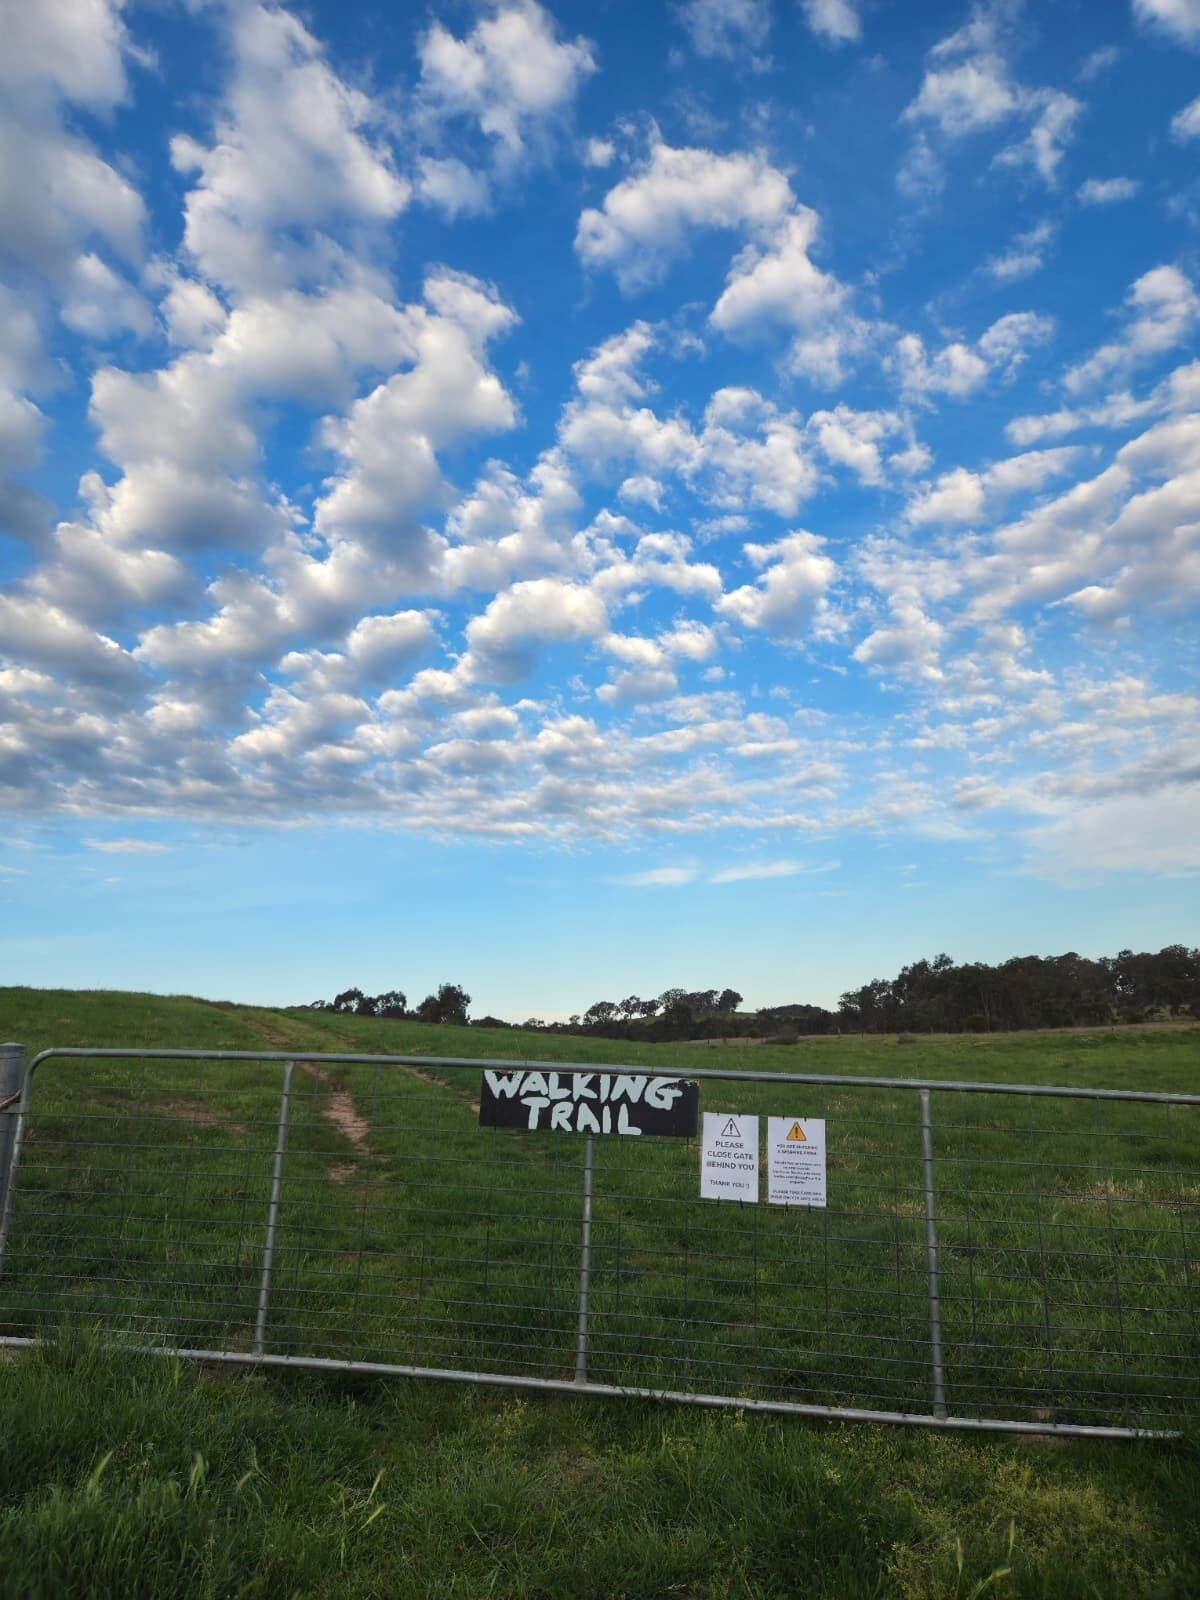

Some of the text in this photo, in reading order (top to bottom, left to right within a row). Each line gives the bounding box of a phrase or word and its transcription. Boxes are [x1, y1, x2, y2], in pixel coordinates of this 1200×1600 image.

[484, 1069, 683, 1111] WALKING
[521, 1096, 642, 1136] TRAIL
[715, 1140, 745, 1149] PLEASE
[707, 1150, 754, 1161] CLOSE GATE
[706, 1161, 755, 1171] BEHIND YOU
[710, 1179, 730, 1187] THANK
[732, 1181, 745, 1189] YOU
